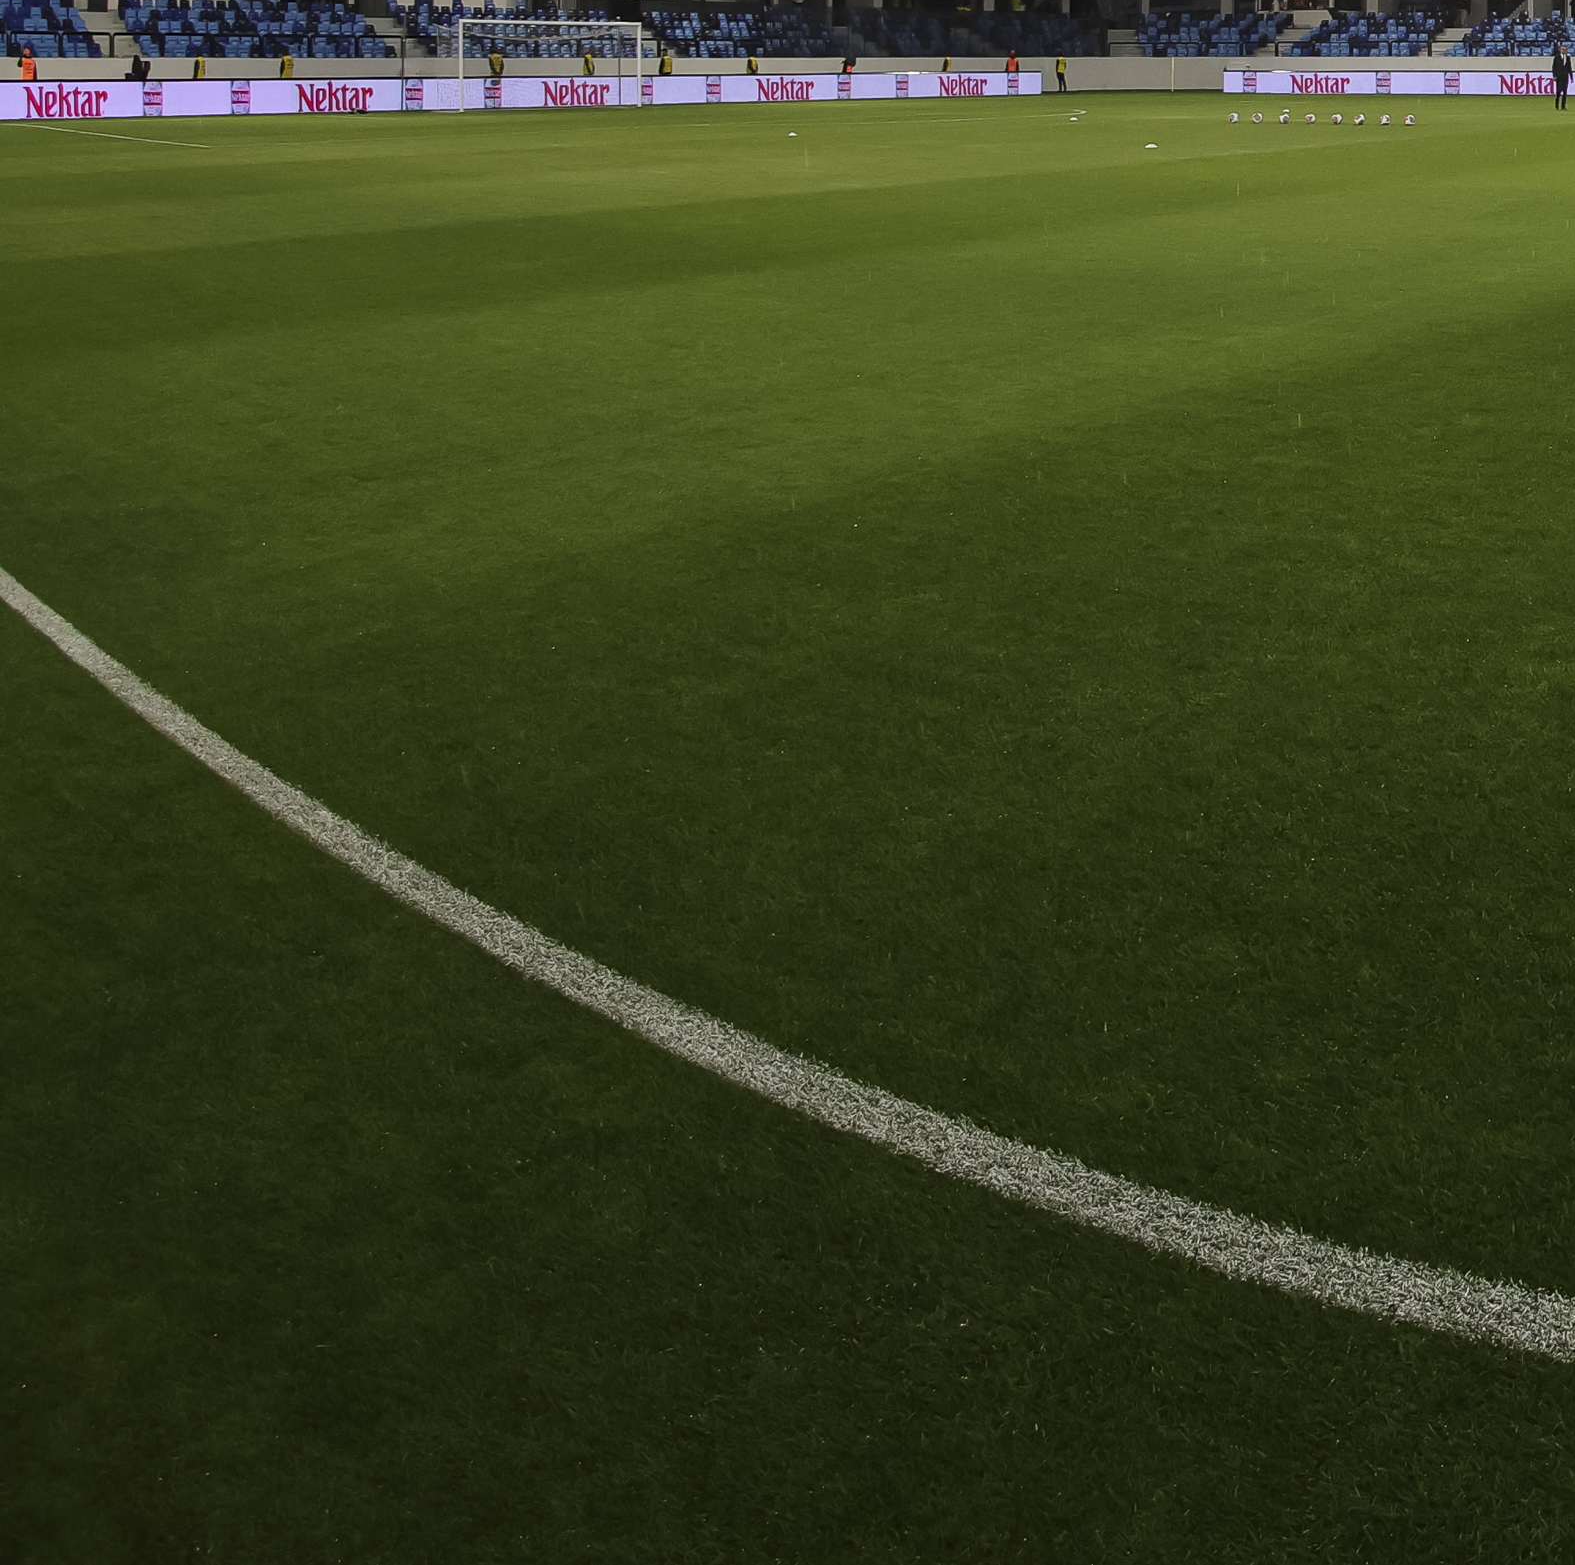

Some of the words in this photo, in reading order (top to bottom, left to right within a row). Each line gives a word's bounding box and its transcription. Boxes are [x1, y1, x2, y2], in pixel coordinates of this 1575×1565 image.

[295, 80, 374, 113] Nektar
[541, 77, 610, 106] Nektar
[756, 76, 815, 102] Nektar
[937, 74, 988, 96] Nektar
[1289, 73, 1350, 94] Nektar
[1498, 72, 1556, 95] Nekta
[23, 82, 109, 118] Nektar
